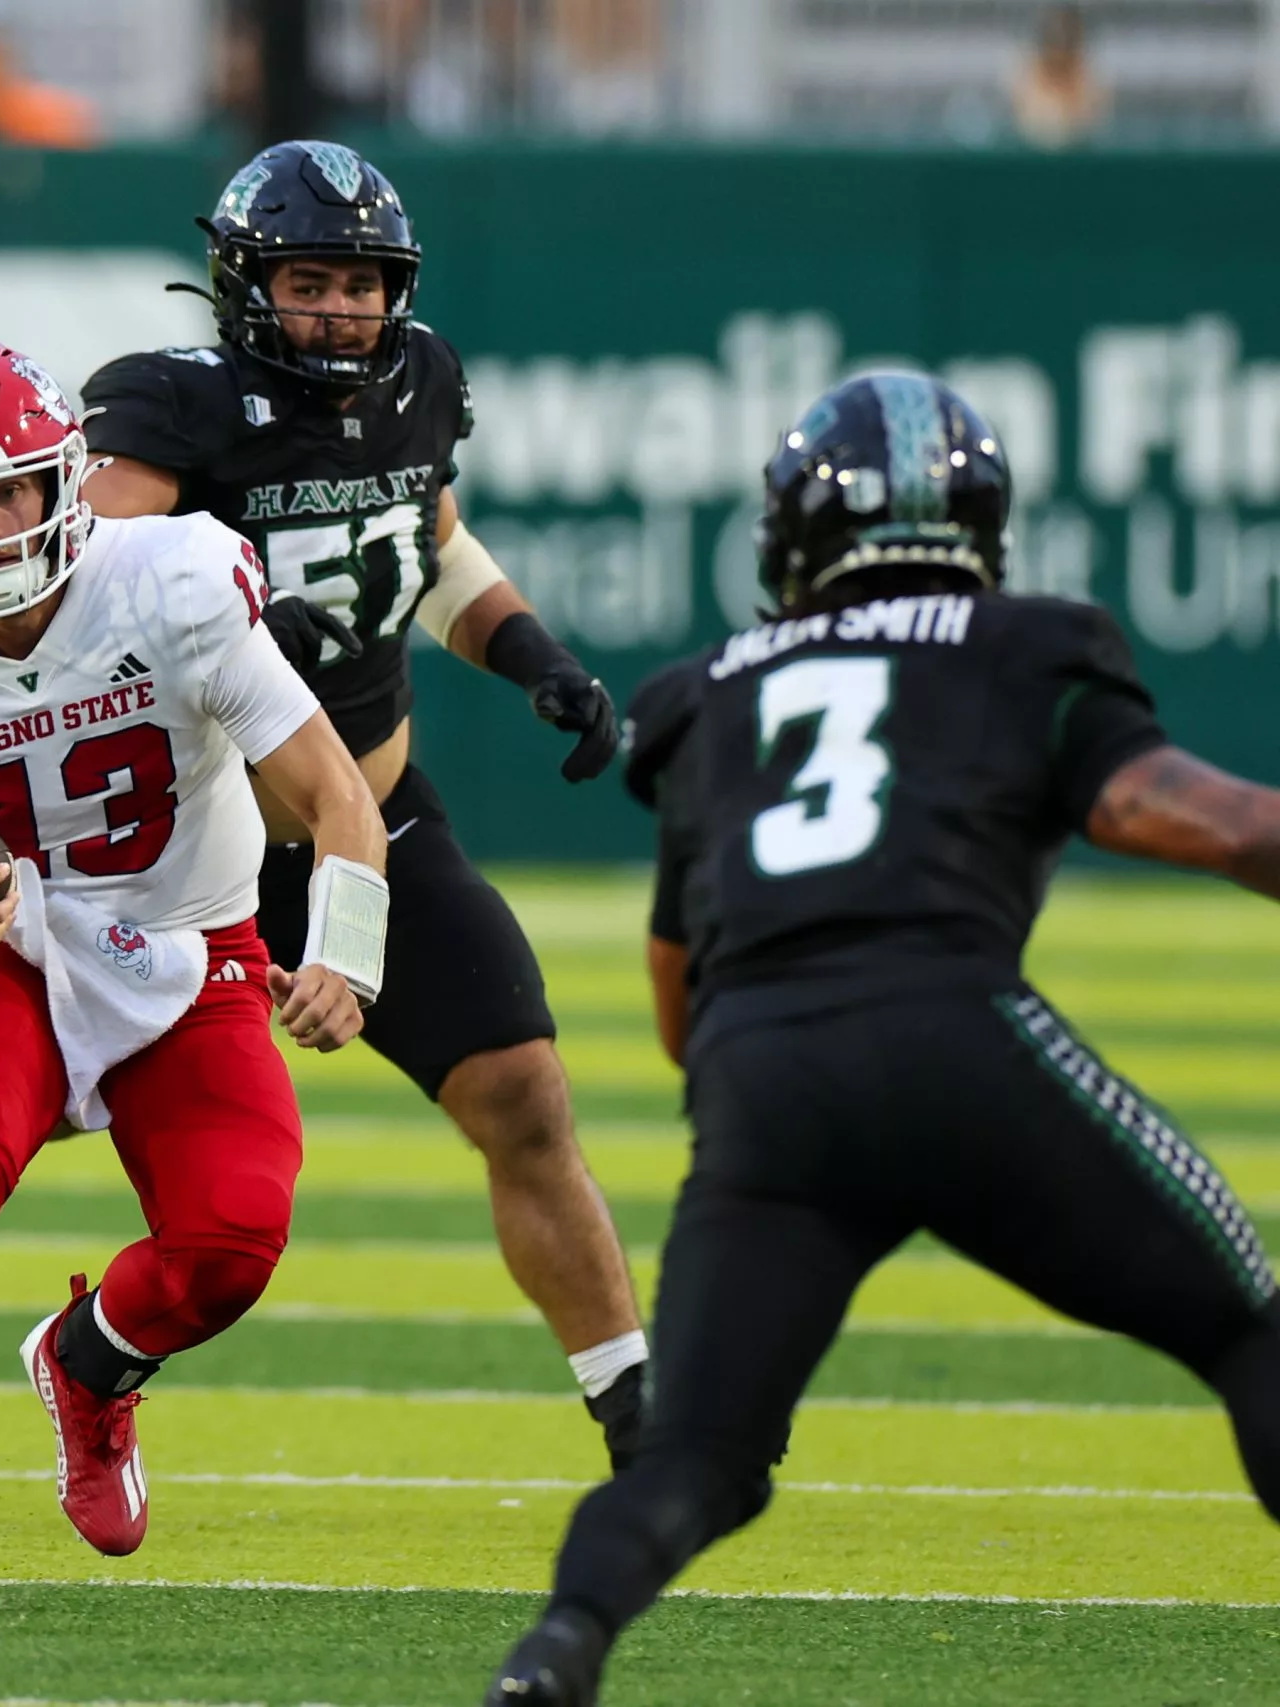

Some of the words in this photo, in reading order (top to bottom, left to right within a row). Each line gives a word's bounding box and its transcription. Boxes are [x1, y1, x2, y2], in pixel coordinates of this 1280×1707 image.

[835, 594, 975, 645] SMITH
[61, 680, 156, 731] STATE
[750, 655, 893, 878] 3
